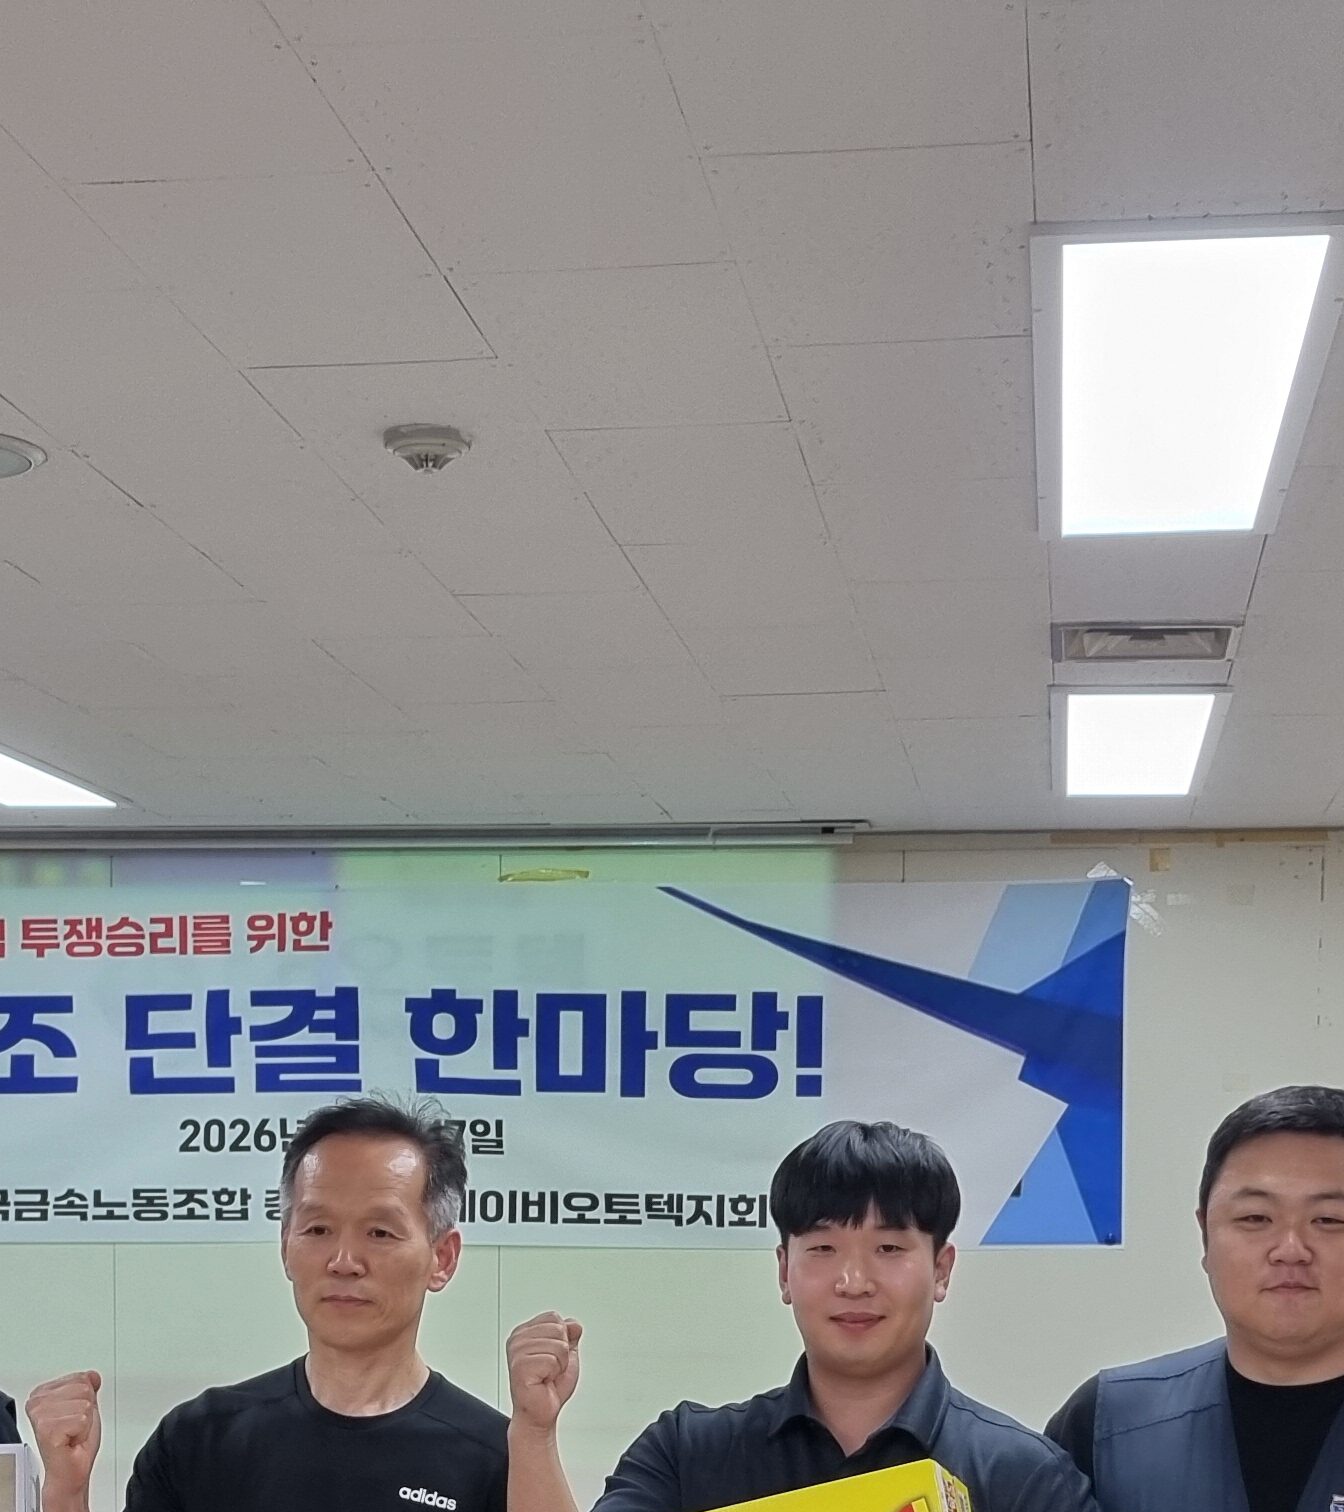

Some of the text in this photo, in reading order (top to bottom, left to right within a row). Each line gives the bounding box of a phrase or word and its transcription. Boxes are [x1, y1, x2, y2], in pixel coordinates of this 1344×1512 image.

[21, 914, 233, 958] 투쟁승리를
[246, 910, 333, 954] 위한
[125, 986, 363, 1096] 단결
[404, 988, 824, 1100] 한마당!
[398, 1486, 456, 1511] adidas
